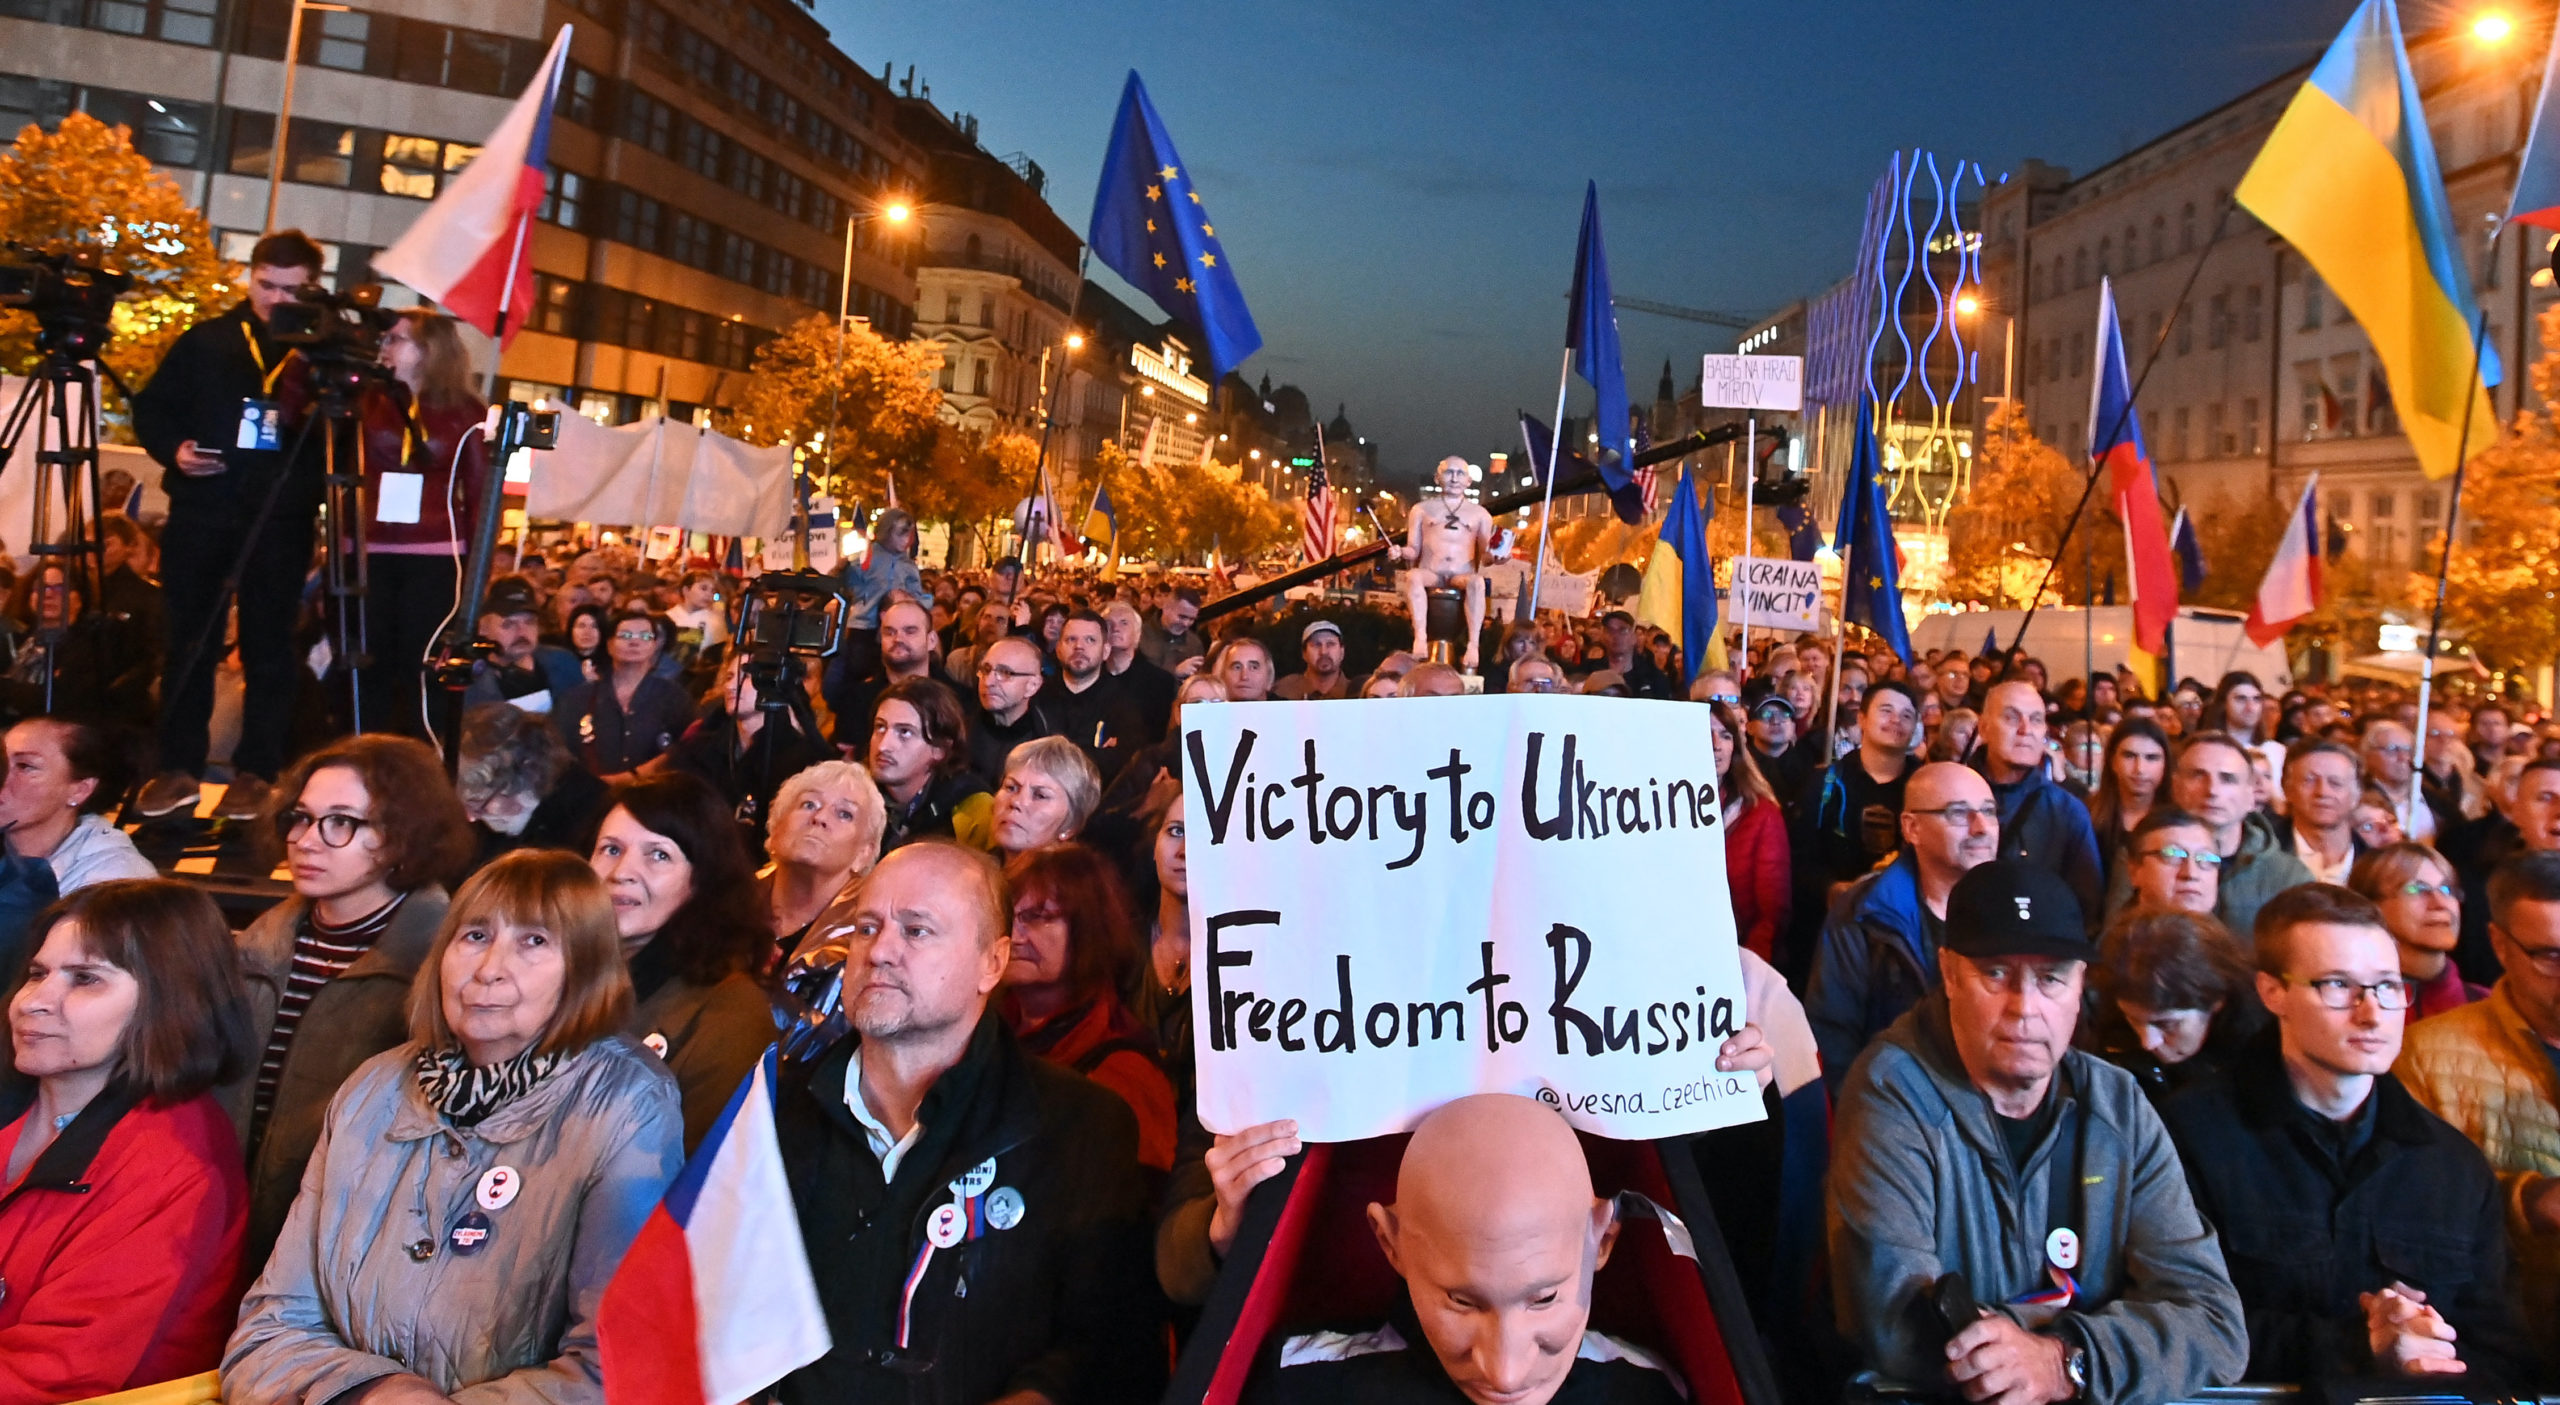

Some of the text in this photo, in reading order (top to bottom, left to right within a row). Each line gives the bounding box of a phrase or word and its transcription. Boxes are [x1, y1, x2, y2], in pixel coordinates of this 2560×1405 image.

[1745, 360, 1760, 380] NA
[1763, 360, 1797, 382] HRAD
[1737, 562, 1819, 590] UCRAINA
[1185, 728, 1717, 871] Victory to Ukraine
[1206, 909, 1741, 1057] Freedom to Russia
[1536, 1074, 1747, 1115] @vesna_czechia
